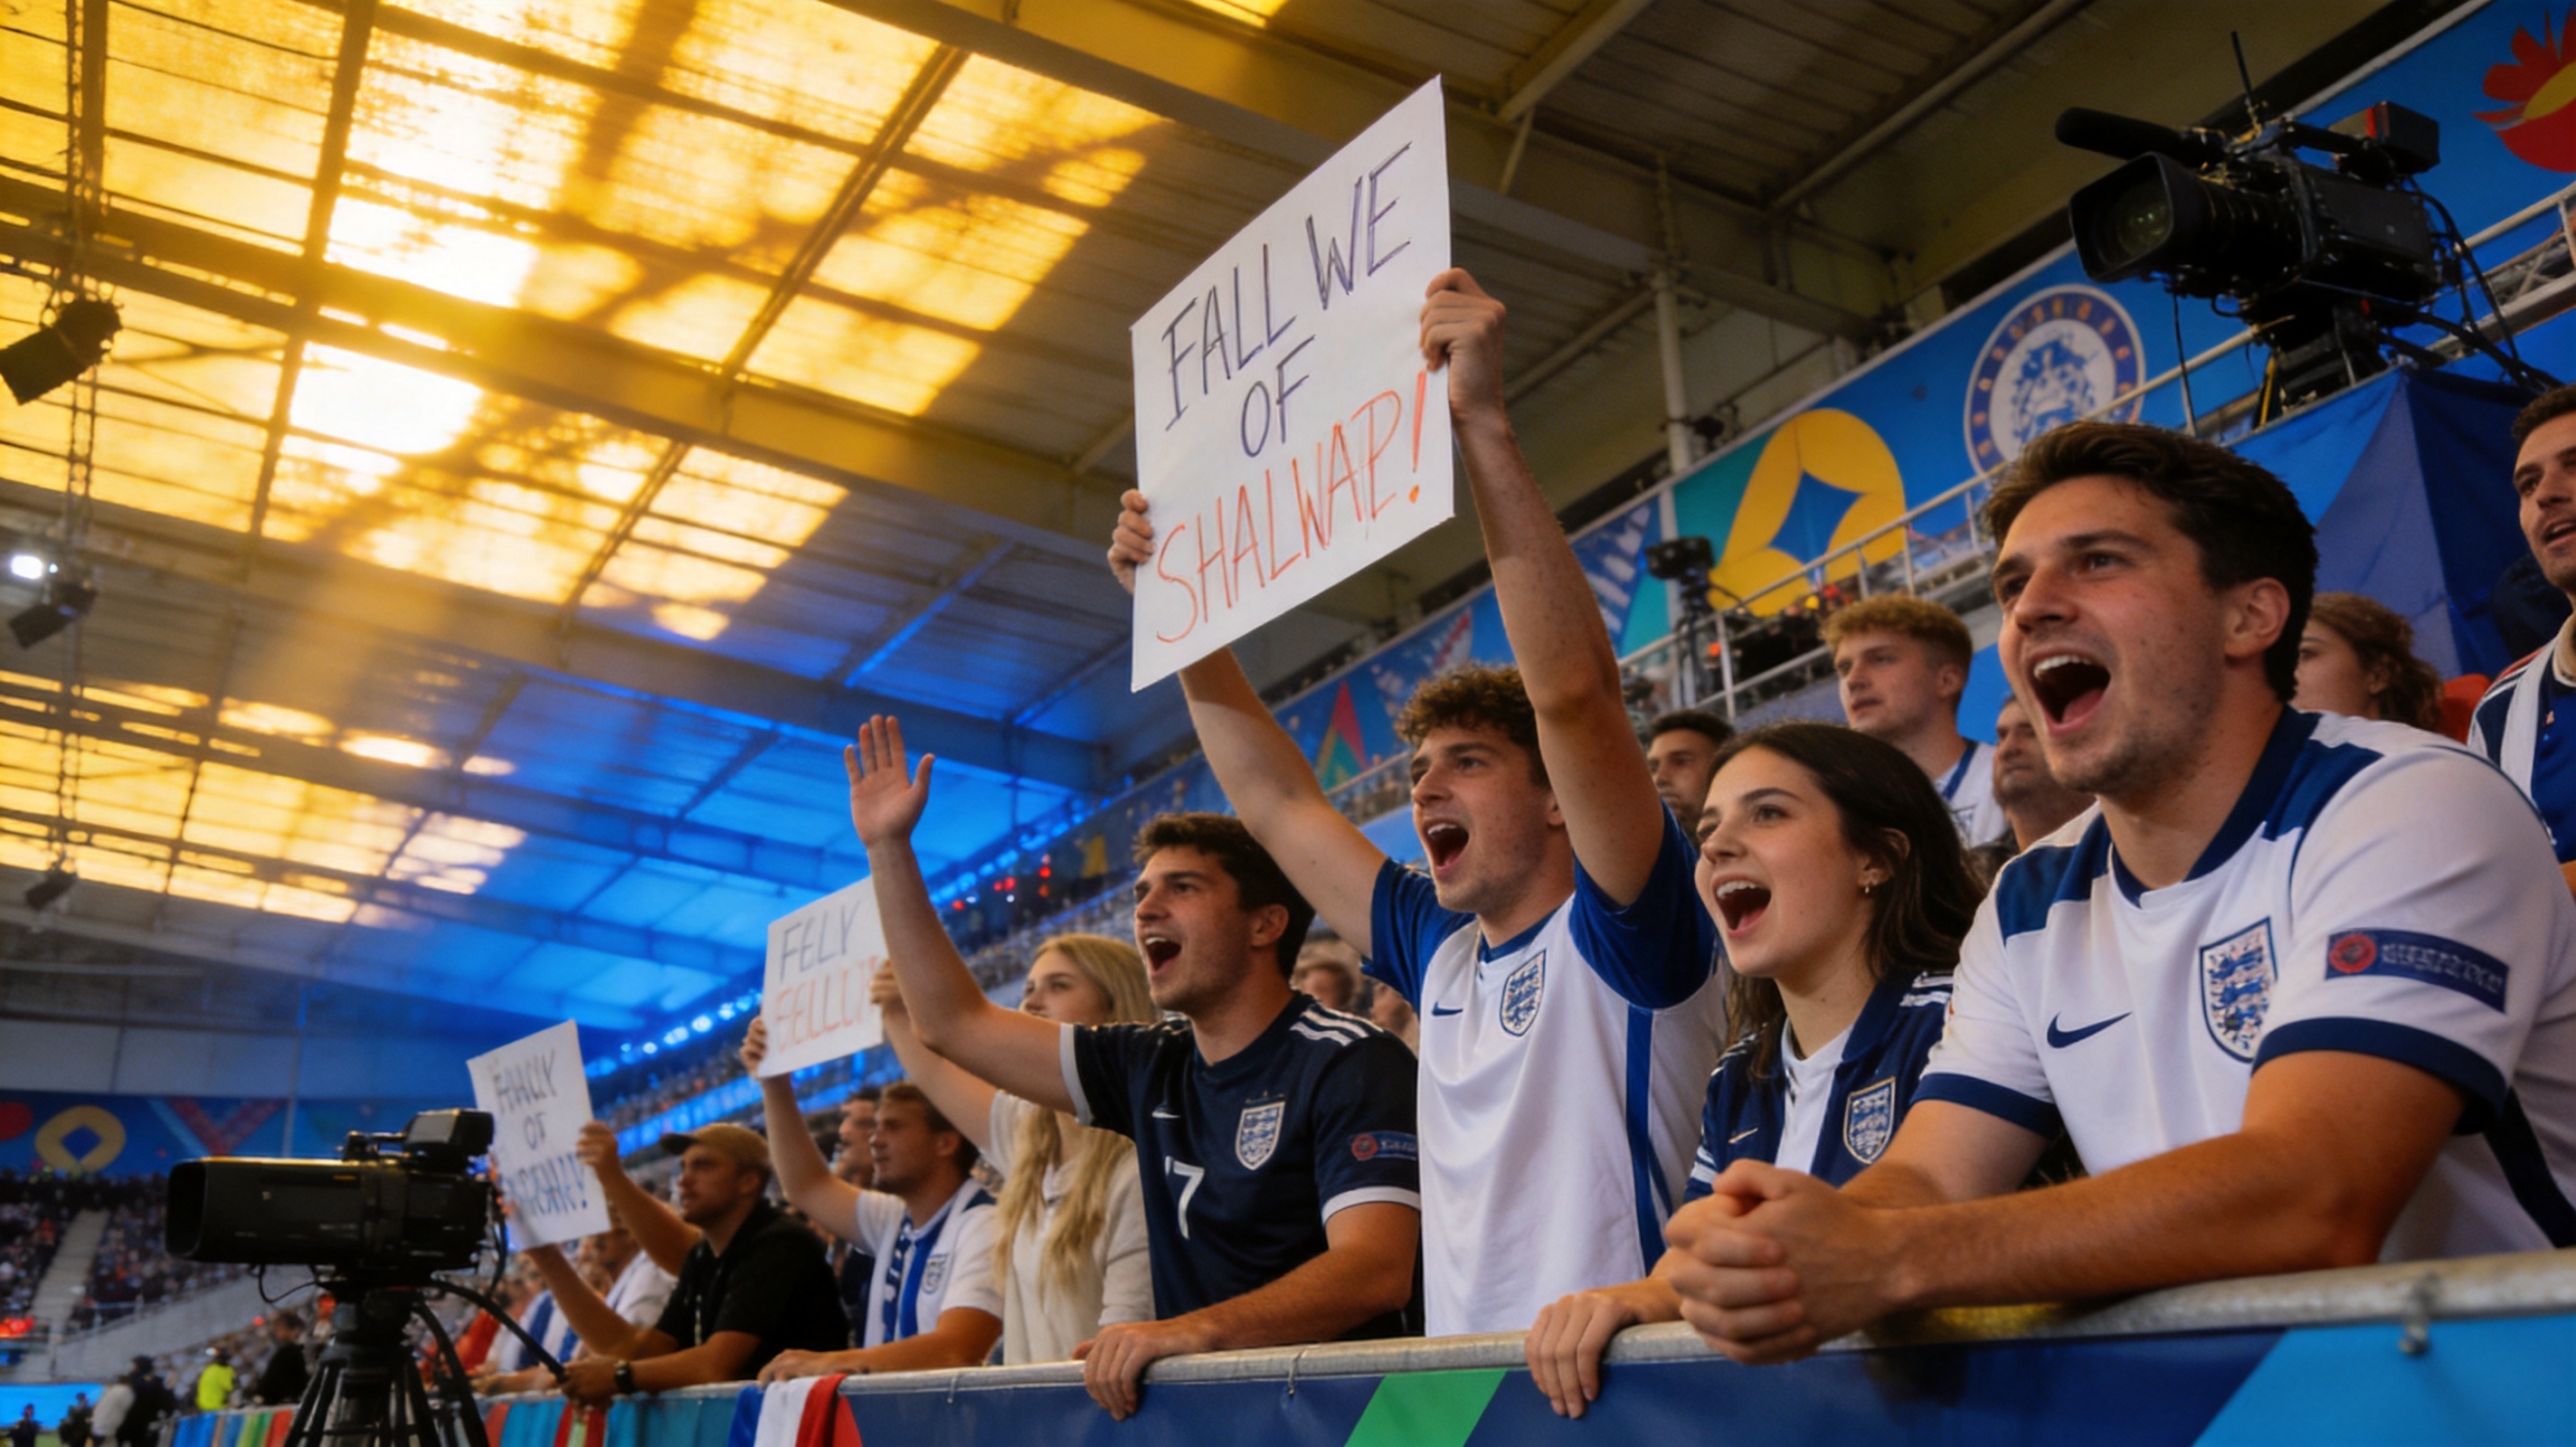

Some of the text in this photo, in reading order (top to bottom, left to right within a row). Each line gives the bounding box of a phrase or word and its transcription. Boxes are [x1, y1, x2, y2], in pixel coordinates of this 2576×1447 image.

[1162, 142, 1412, 431] FALL WE
[1241, 334, 1316, 458] OF
